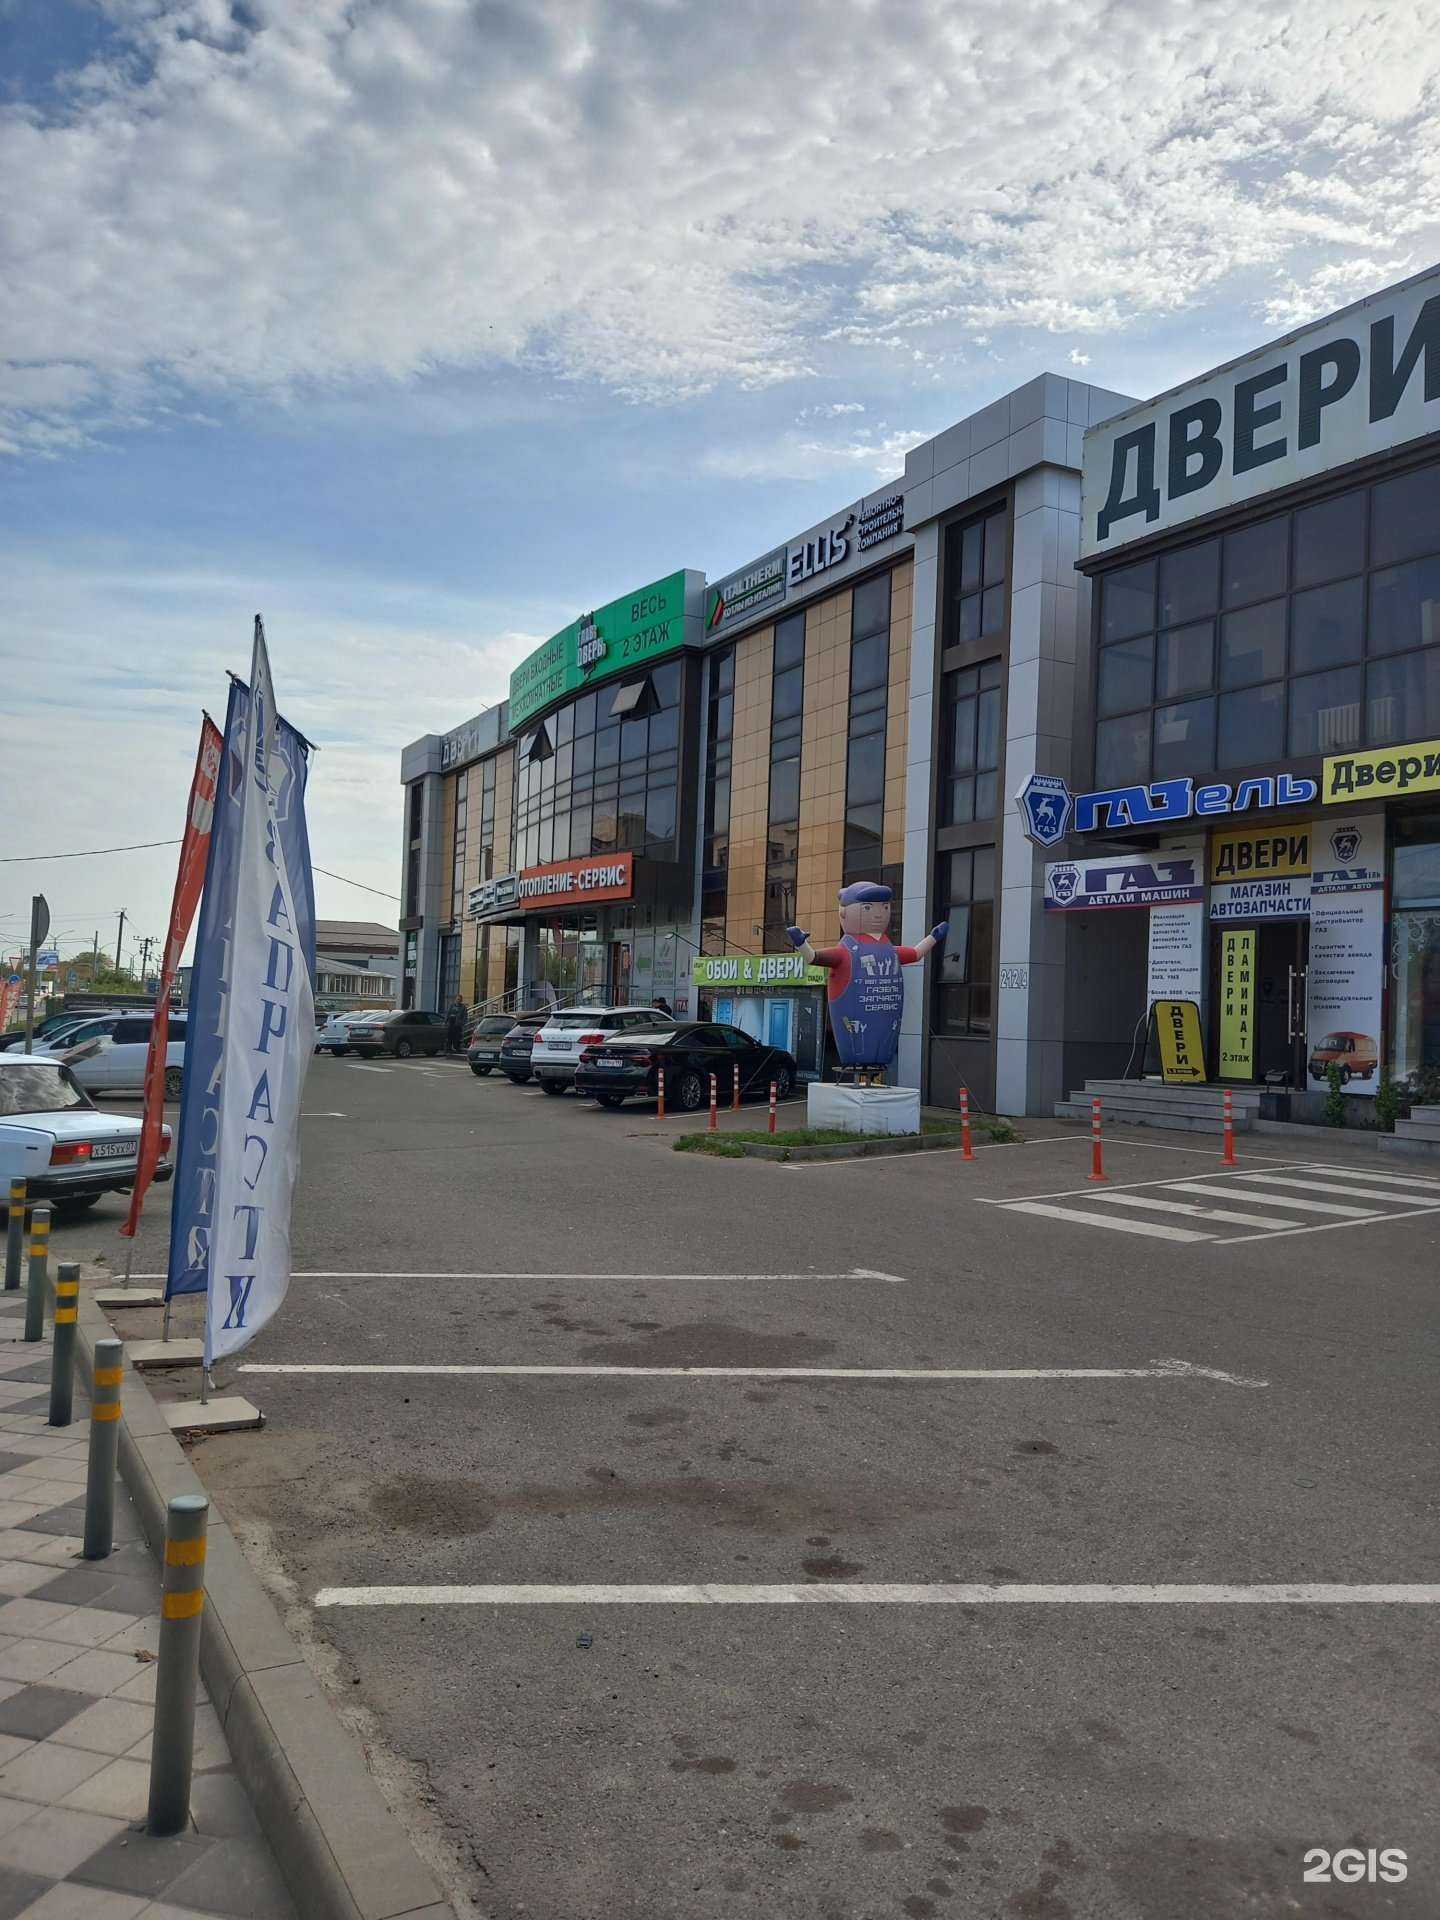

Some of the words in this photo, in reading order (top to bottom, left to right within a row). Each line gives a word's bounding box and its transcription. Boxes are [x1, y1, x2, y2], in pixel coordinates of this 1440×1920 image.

[1097, 294, 1440, 541] ДВЕРИ
[787, 524, 849, 587] ELLIS
[632, 593, 666, 622] ВЕСЬ
[624, 639, 630, 656] 2
[633, 622, 670, 652] ЭТАЖ
[1331, 752, 1440, 796] Двери
[1037, 824, 1057, 834] ГАЗ
[1215, 835, 1308, 877] ДВЕРИ
[1085, 859, 1195, 893] ГАЗ
[1230, 882, 1291, 899] МАГАЗИН
[1088, 894, 1135, 905] ДЕТАЛИ
[1141, 889, 1190, 901] МАШИН
[1210, 898, 1311, 916] АВТОЗАПЧАСТИ
[706, 959, 738, 980] ОБОИ
[743, 958, 753, 979] &
[757, 956, 804, 983] ДВЕРИ
[1226, 938, 1235, 1016] ДВЕРИ
[1240, 937, 1250, 1050] ЛАМИНАТ
[1170, 1006, 1189, 1065] ДВЕРИ
[1222, 1053, 1228, 1062] 2
[1229, 1053, 1250, 1063] этаж
